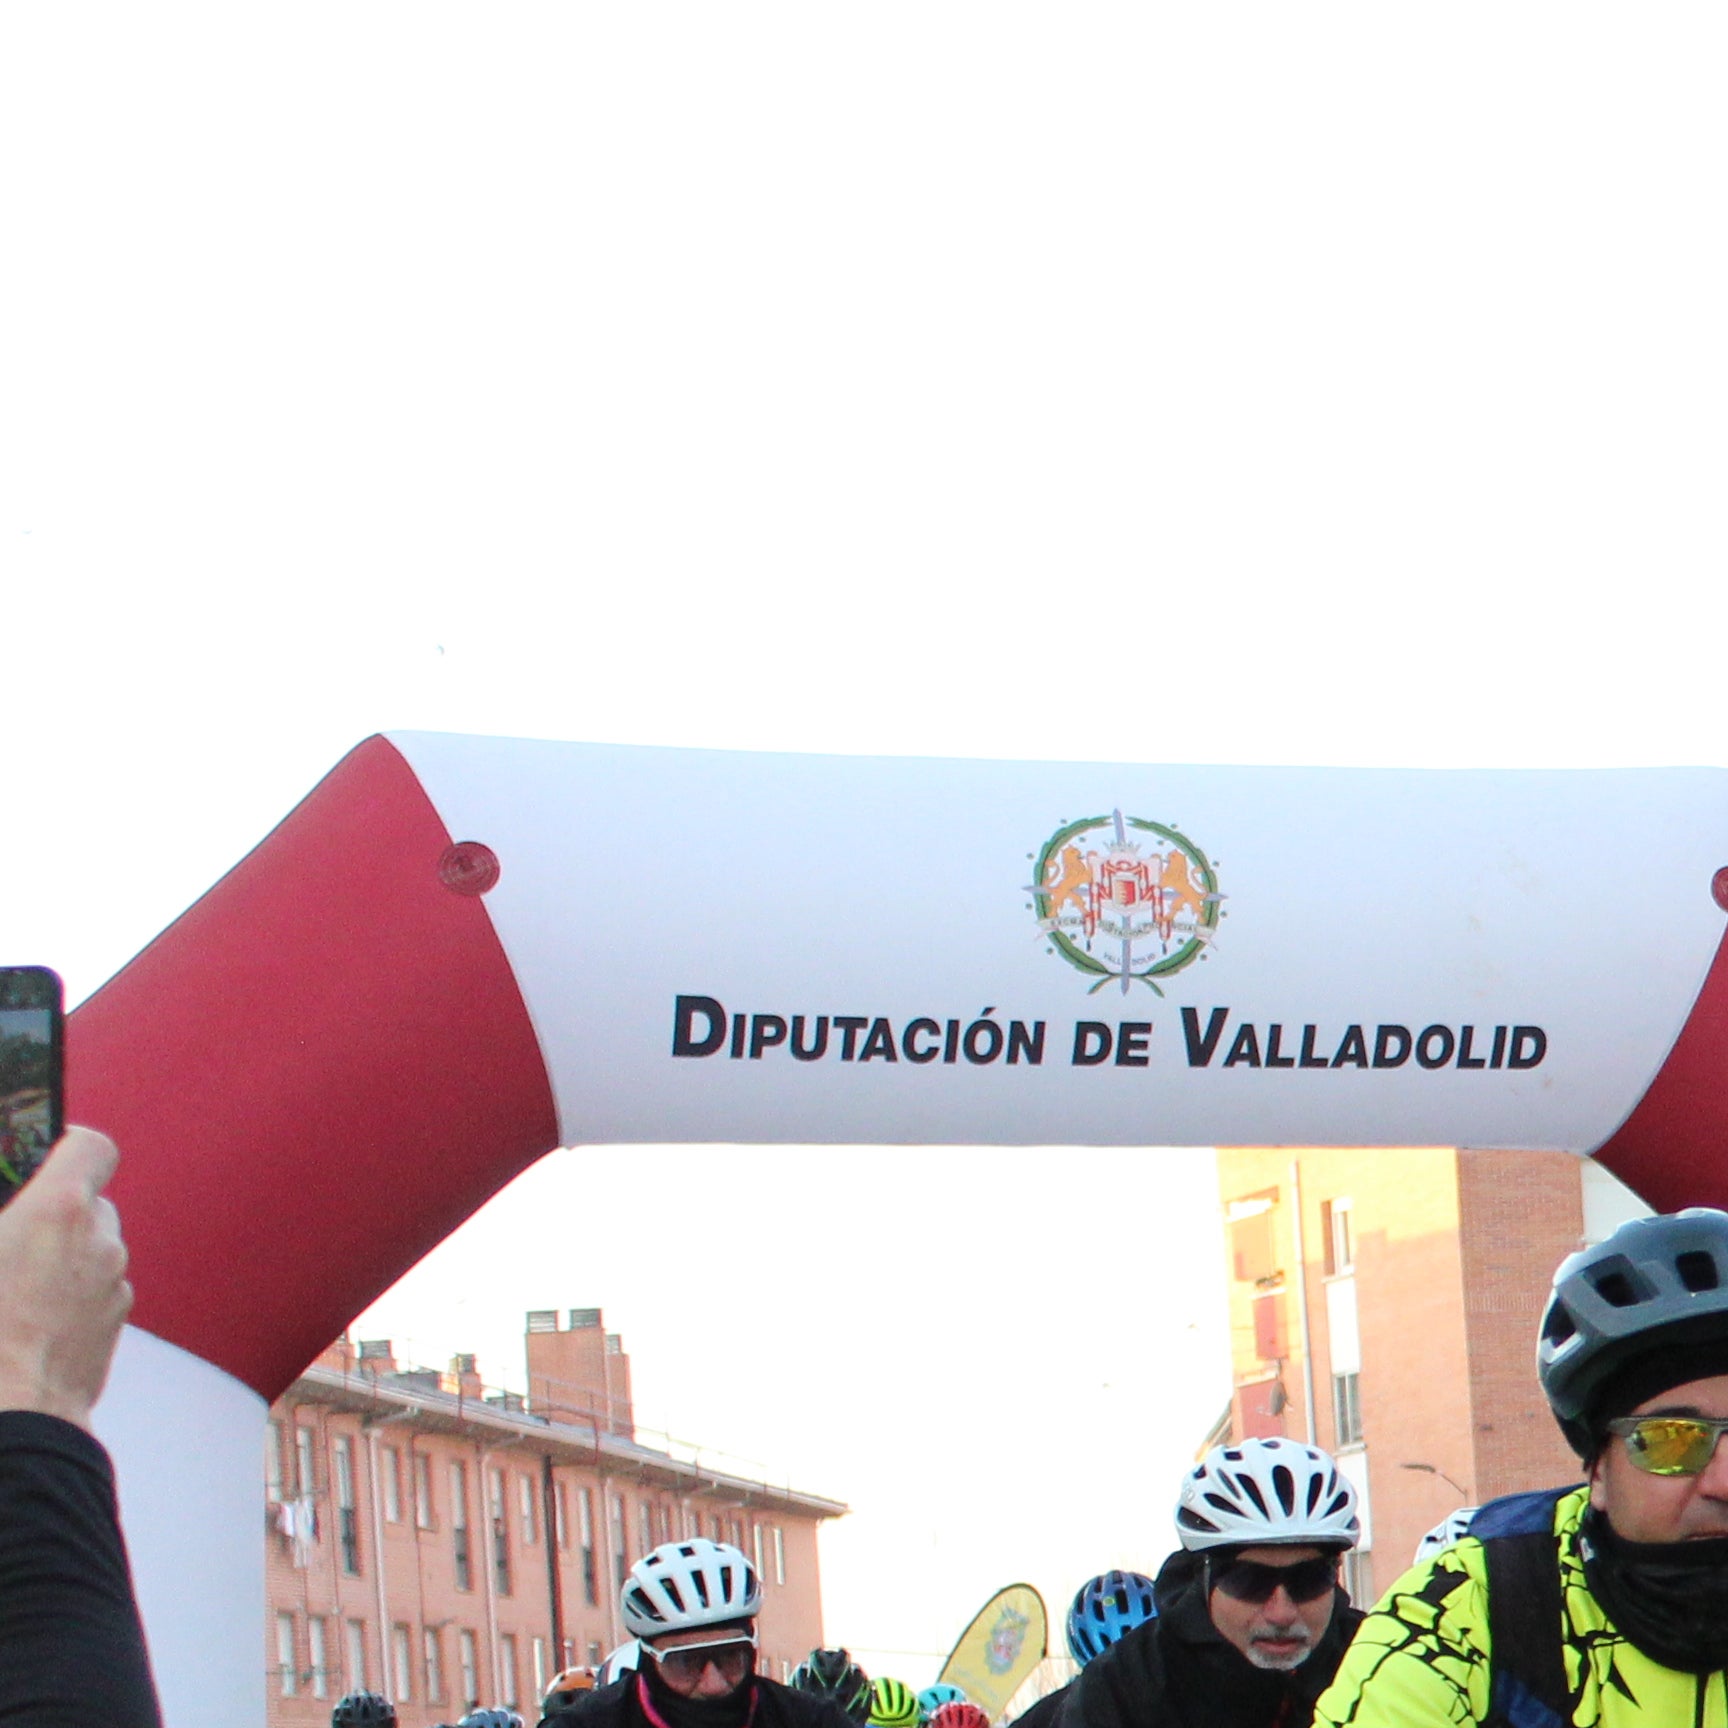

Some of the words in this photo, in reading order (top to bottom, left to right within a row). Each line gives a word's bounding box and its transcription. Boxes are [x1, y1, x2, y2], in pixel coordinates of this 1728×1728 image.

[671, 994, 1046, 1066] DIPUTACIÓN
[1073, 1020, 1153, 1067] DE
[1180, 1006, 1548, 1070] VALLADOLID
